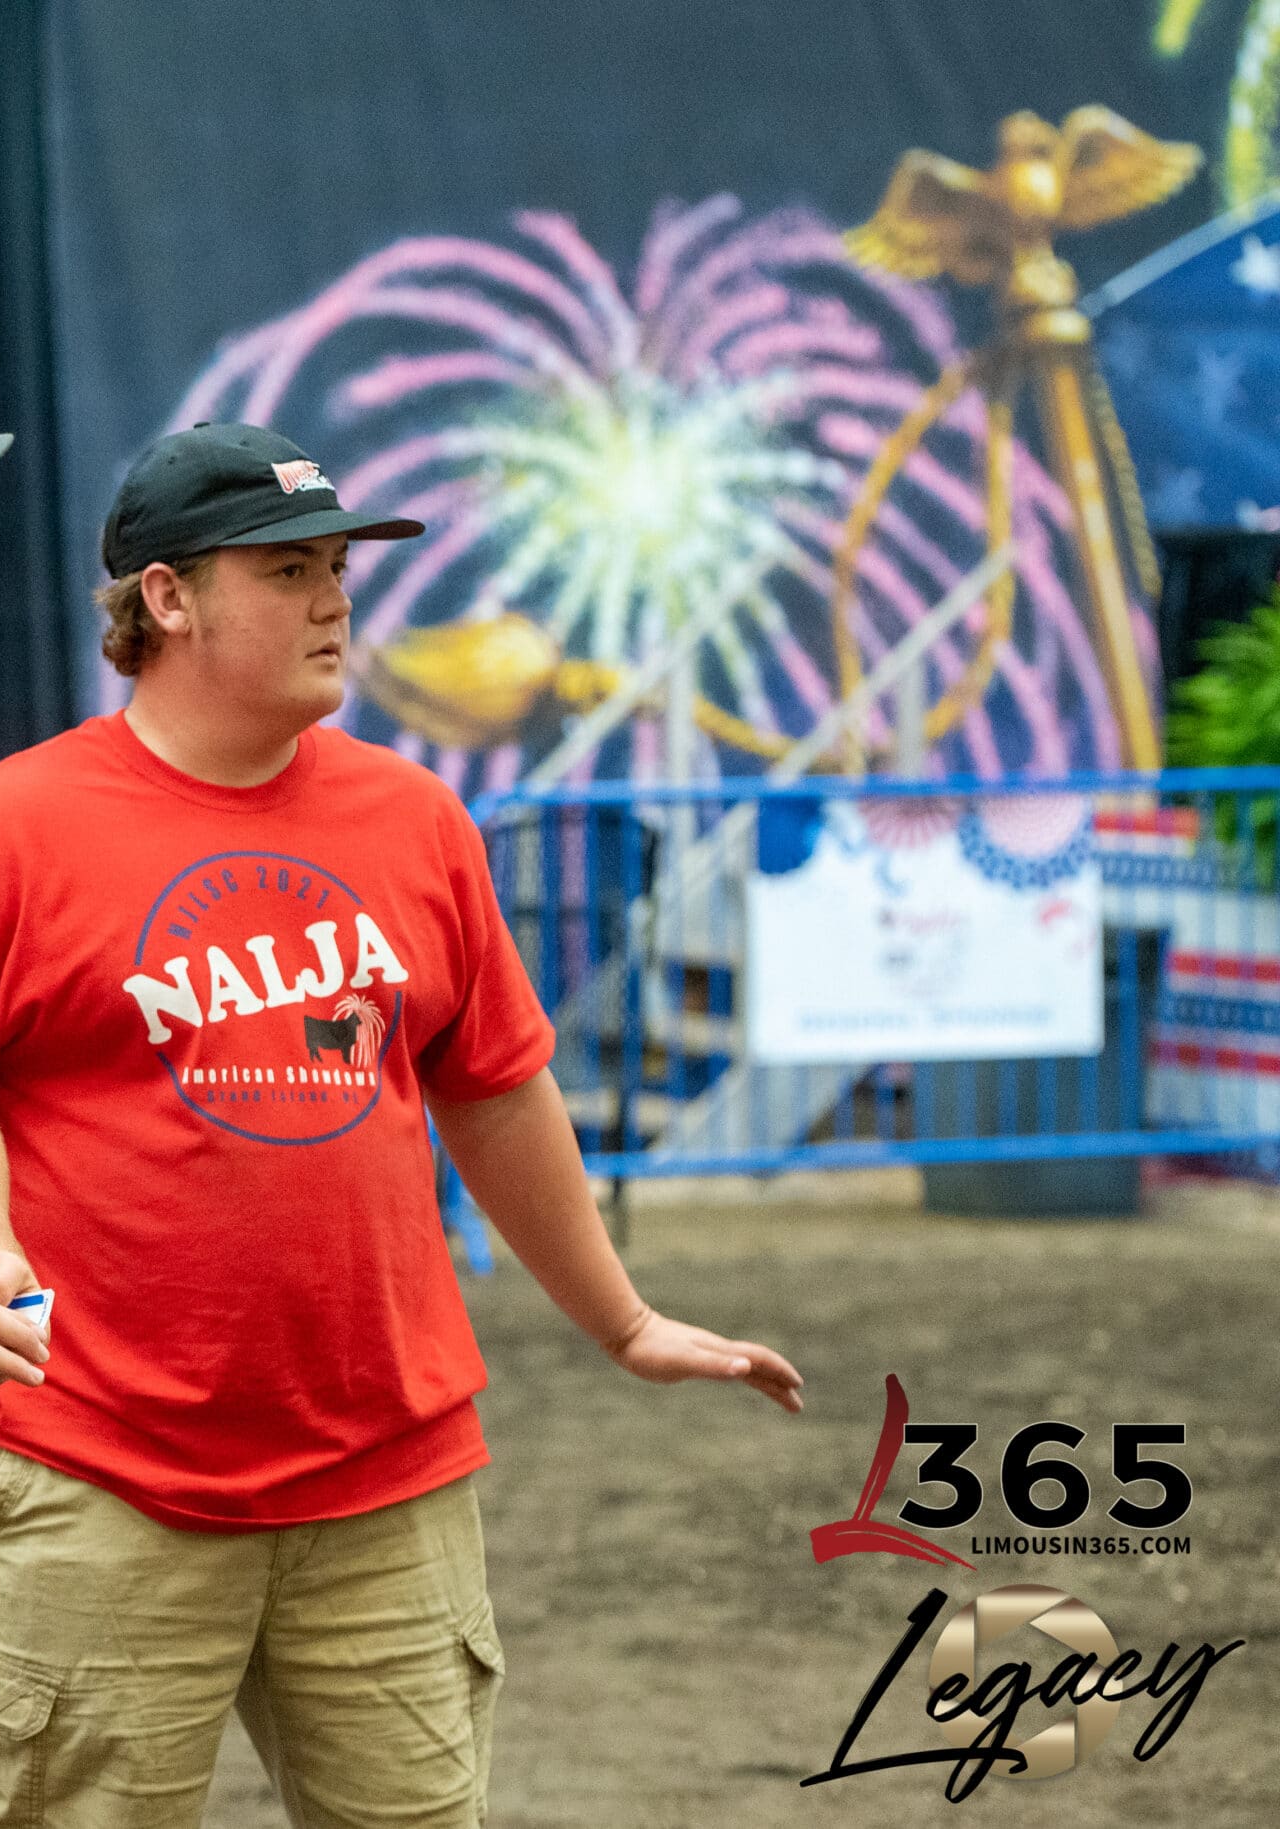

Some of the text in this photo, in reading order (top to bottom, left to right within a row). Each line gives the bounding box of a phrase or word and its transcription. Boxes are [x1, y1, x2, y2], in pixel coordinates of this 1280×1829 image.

[255, 864, 330, 910] 2021
[123, 912, 409, 1045] NALJA
[181, 1064, 377, 1087] American Showdown
